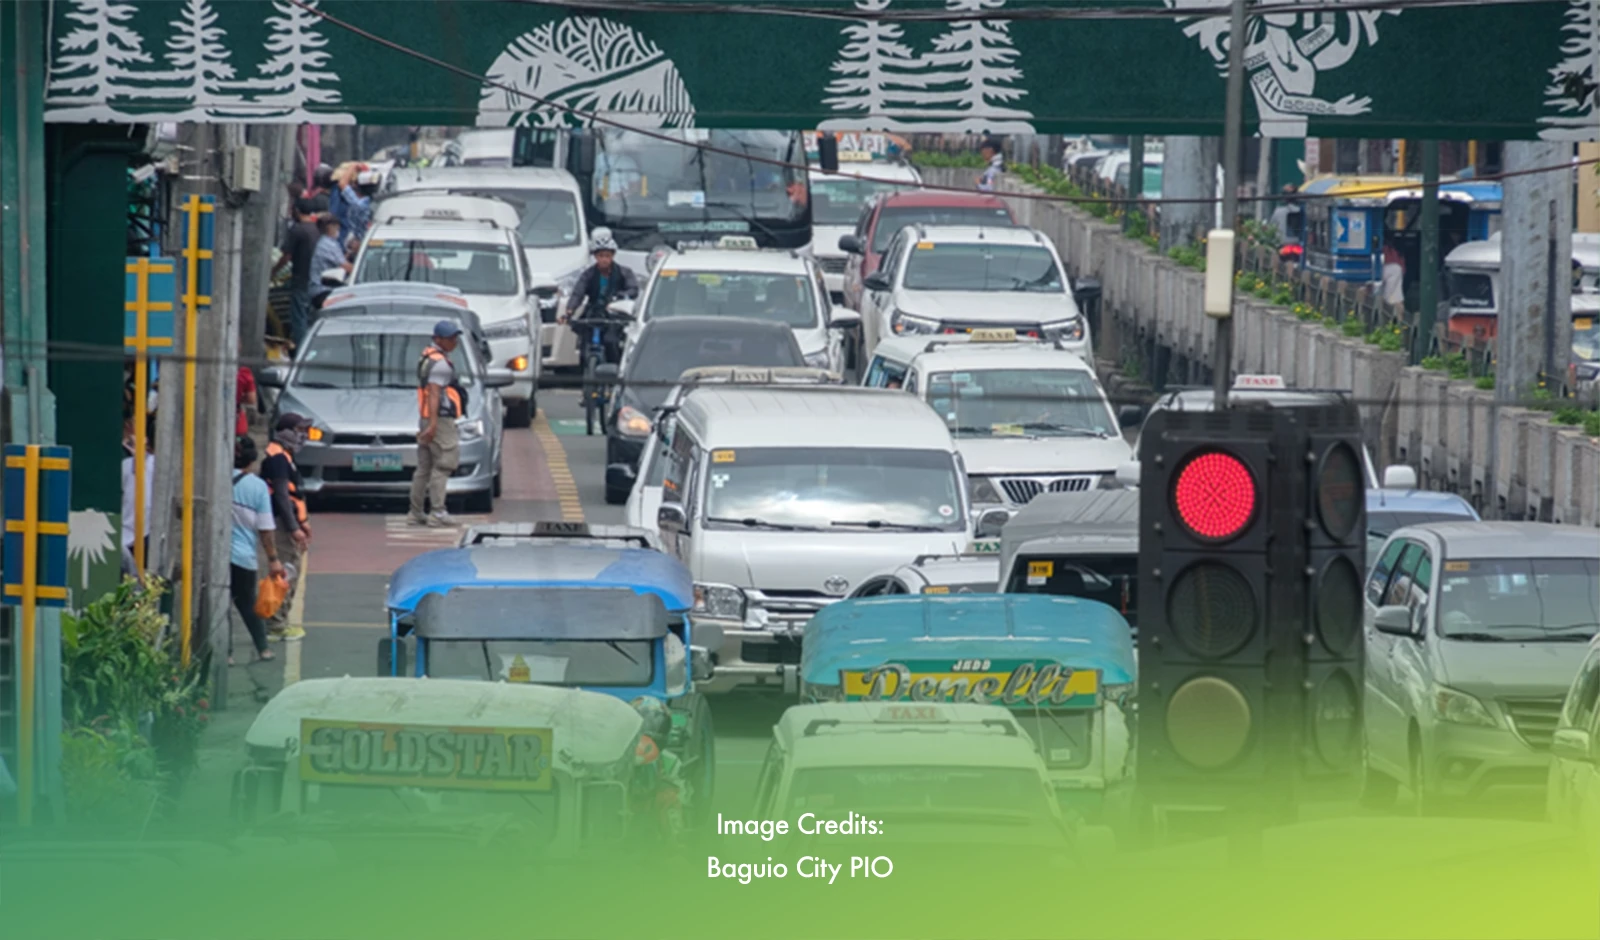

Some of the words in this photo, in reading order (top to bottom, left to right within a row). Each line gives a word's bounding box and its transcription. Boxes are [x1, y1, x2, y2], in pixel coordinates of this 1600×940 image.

[725, 239, 753, 247] TAXI
[1244, 377, 1276, 386] TAXI
[543, 522, 582, 532] TAXI
[973, 541, 1001, 552] TAX
[888, 706, 937, 721] TAXI
[310, 726, 544, 783] GOLDSTAR
